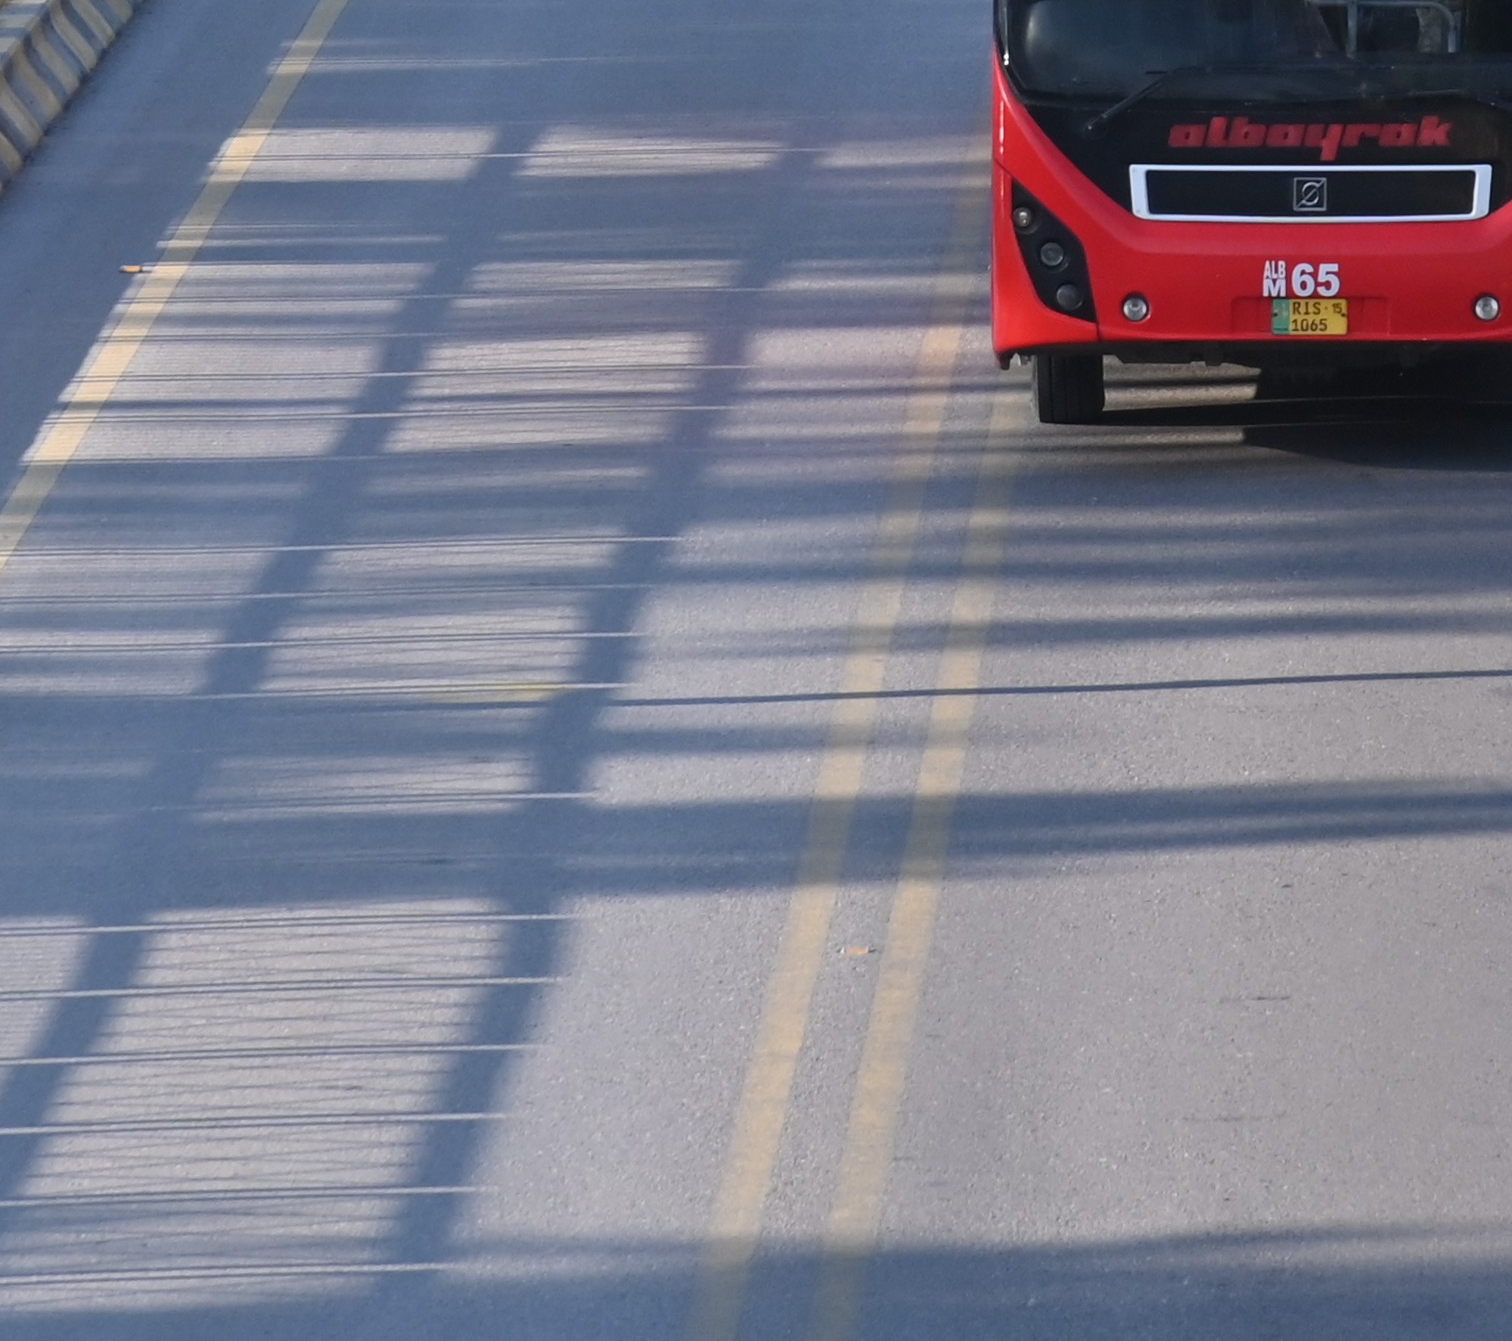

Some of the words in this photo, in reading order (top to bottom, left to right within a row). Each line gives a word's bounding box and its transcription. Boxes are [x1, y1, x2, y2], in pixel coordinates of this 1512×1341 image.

[1167, 116, 1454, 161] albayrak
[1264, 260, 1287, 280] ALB
[1291, 262, 1341, 298] 65
[1262, 278, 1287, 298] M
[1292, 301, 1321, 316] RIS
[1291, 318, 1328, 332] 1065
